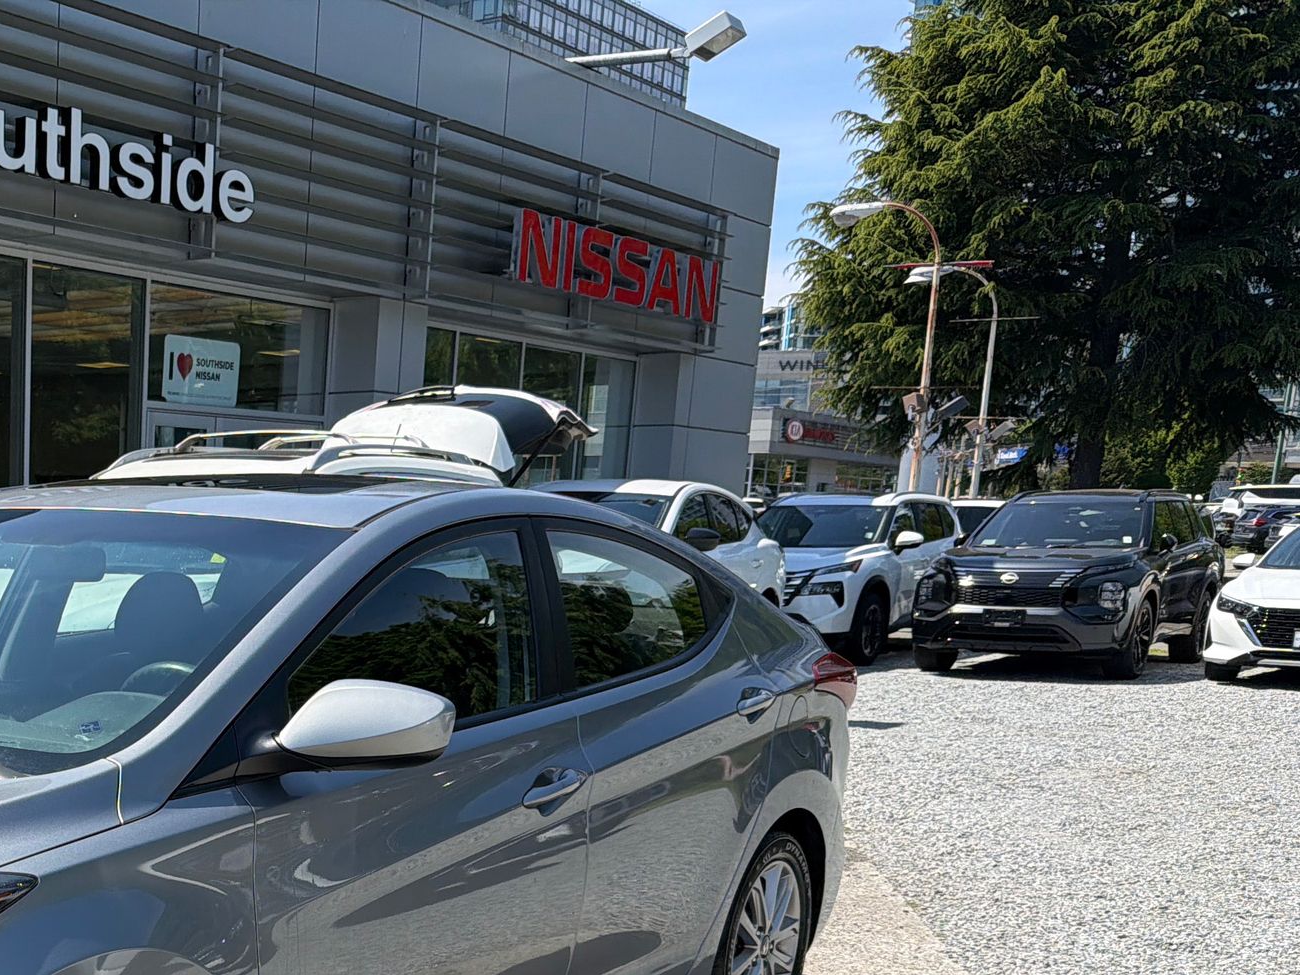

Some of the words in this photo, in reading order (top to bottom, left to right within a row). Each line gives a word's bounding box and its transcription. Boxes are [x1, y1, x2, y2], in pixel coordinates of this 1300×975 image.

[516, 208, 719, 324] NISSAN
[168, 351, 175, 381] I
[195, 358, 235, 371] SOUTHSIDE
[779, 359, 825, 371] WIN
[195, 371, 221, 382] NISSAN
